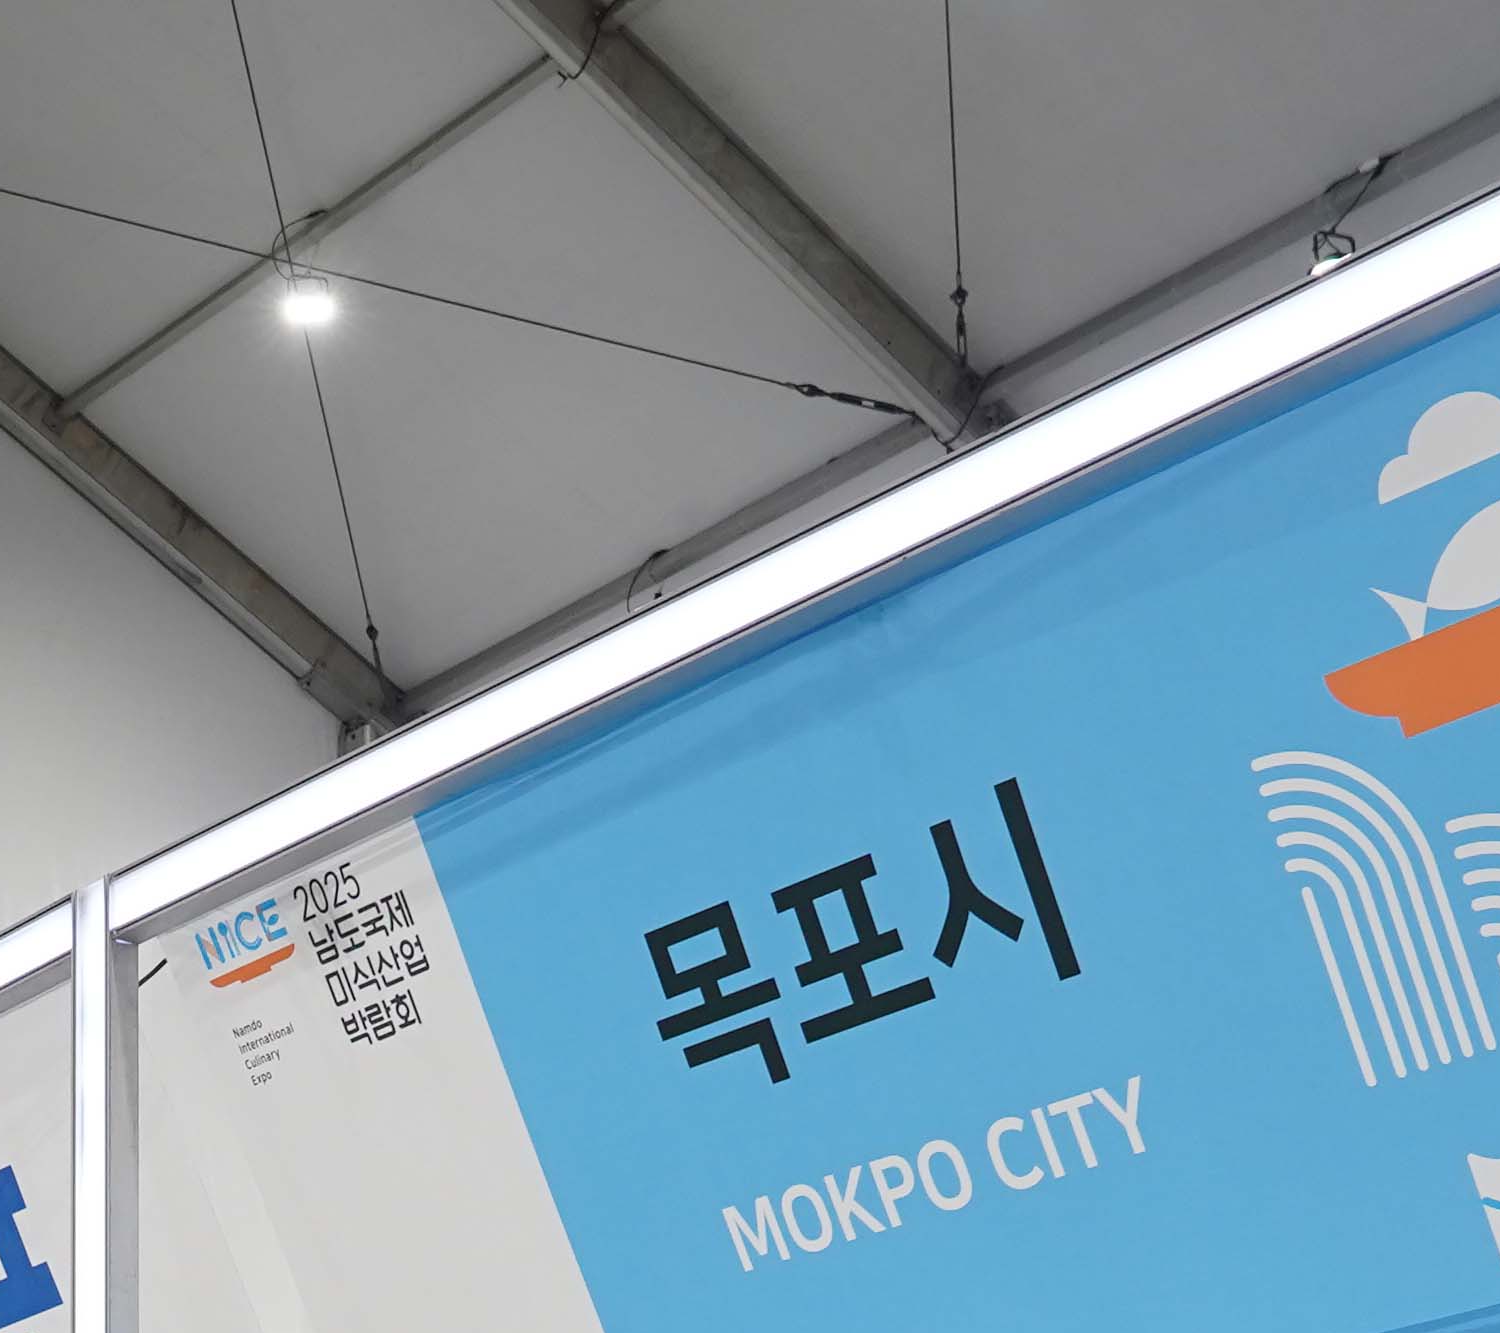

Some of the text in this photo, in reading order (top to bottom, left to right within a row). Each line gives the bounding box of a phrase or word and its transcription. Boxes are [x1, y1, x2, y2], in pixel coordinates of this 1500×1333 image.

[293, 863, 360, 922] 2025
[195, 898, 288, 970] NICE
[308, 890, 414, 965] 남도국제
[644, 777, 1081, 1084] 목포시
[325, 935, 430, 1007] 미식산업
[232, 1019, 263, 1038] Namdo
[238, 1022, 294, 1054] International
[341, 989, 422, 1044] 박람회
[244, 1049, 280, 1070] Culinary
[251, 1071, 272, 1086] Expo
[722, 1075, 1146, 1272] MOKPO CITY
